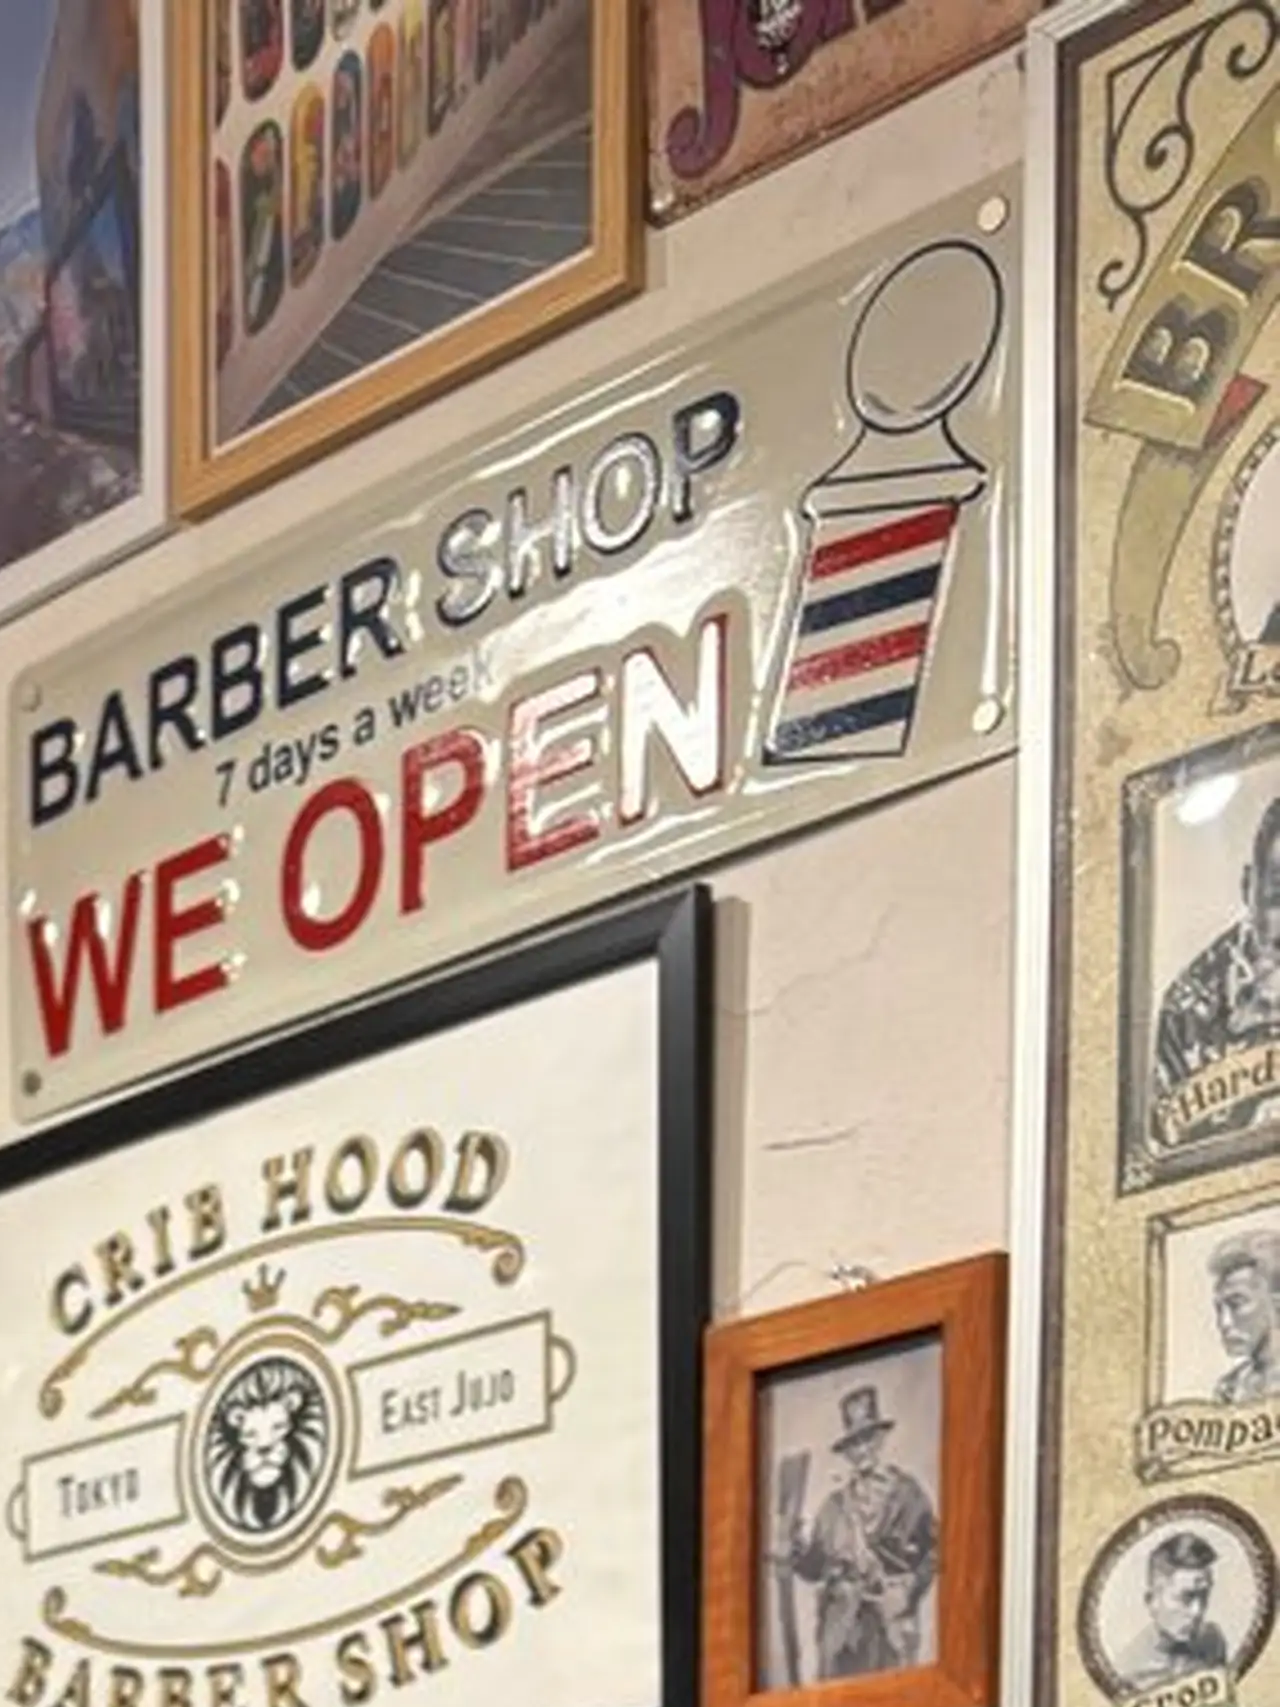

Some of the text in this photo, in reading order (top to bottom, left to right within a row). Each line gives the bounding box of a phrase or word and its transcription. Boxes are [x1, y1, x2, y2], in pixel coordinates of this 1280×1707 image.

[32, 392, 742, 826] BARBER SHOP
[26, 610, 730, 1058] WE OPEN
[214, 653, 496, 808] 7 days a week
[50, 1126, 510, 1336] CRIB HOOD
[335, 1526, 566, 1707] SHOP
